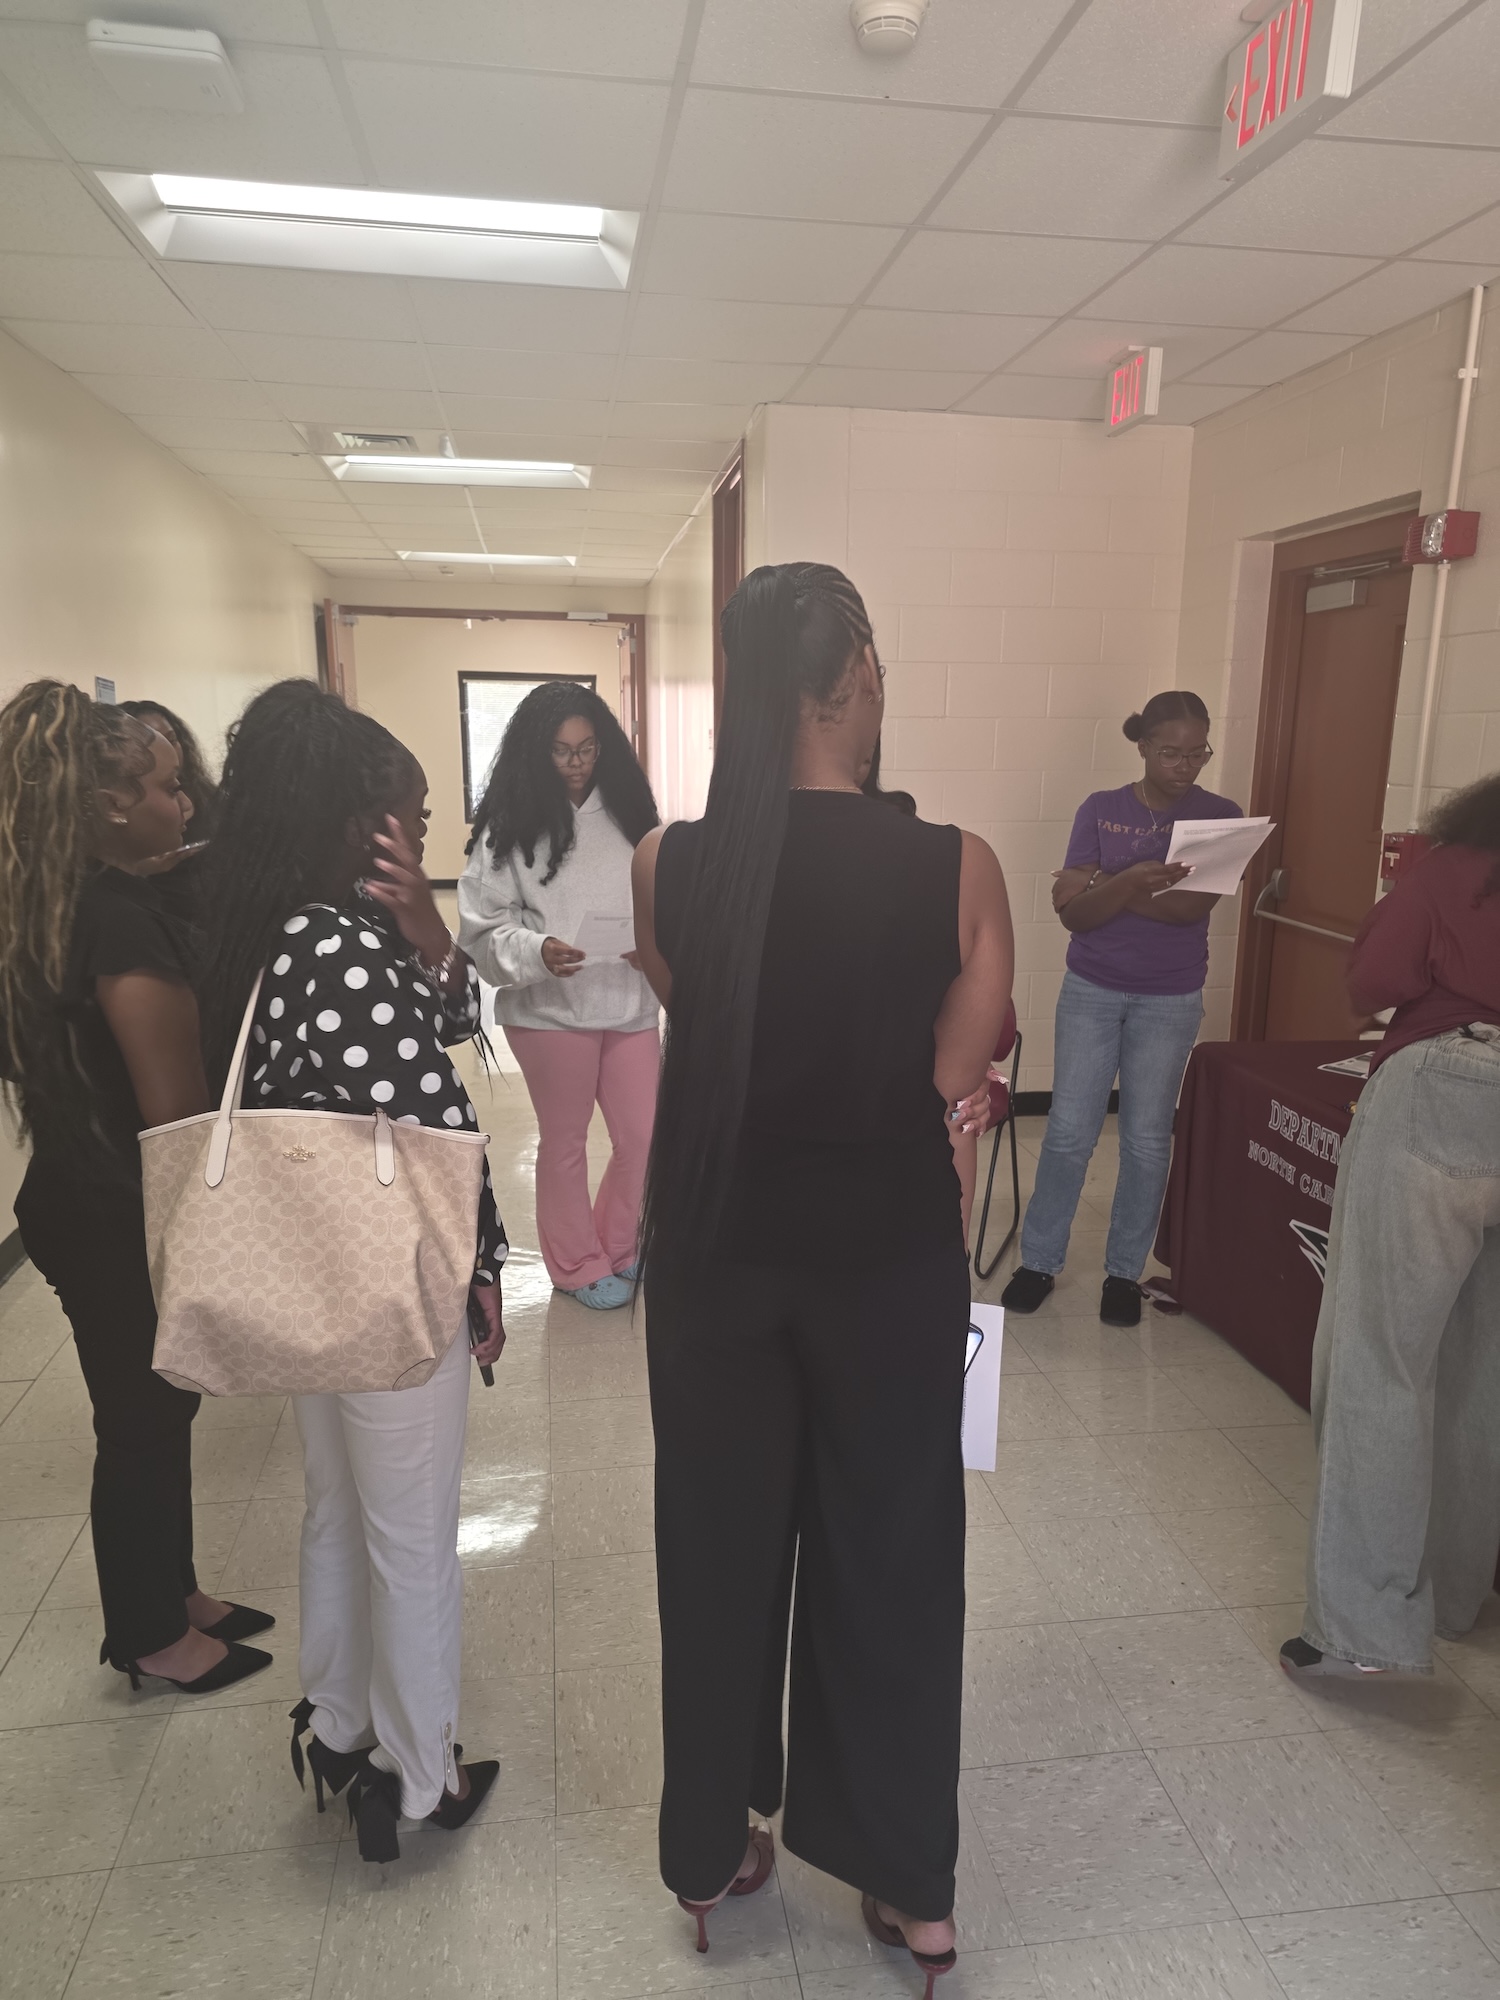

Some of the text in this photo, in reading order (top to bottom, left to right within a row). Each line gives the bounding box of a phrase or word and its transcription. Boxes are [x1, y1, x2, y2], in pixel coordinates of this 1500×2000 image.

[1236, 0, 1314, 150] EXIT
[1111, 355, 1144, 426] EXIT
[1248, 1140, 1296, 1185] NORTH
